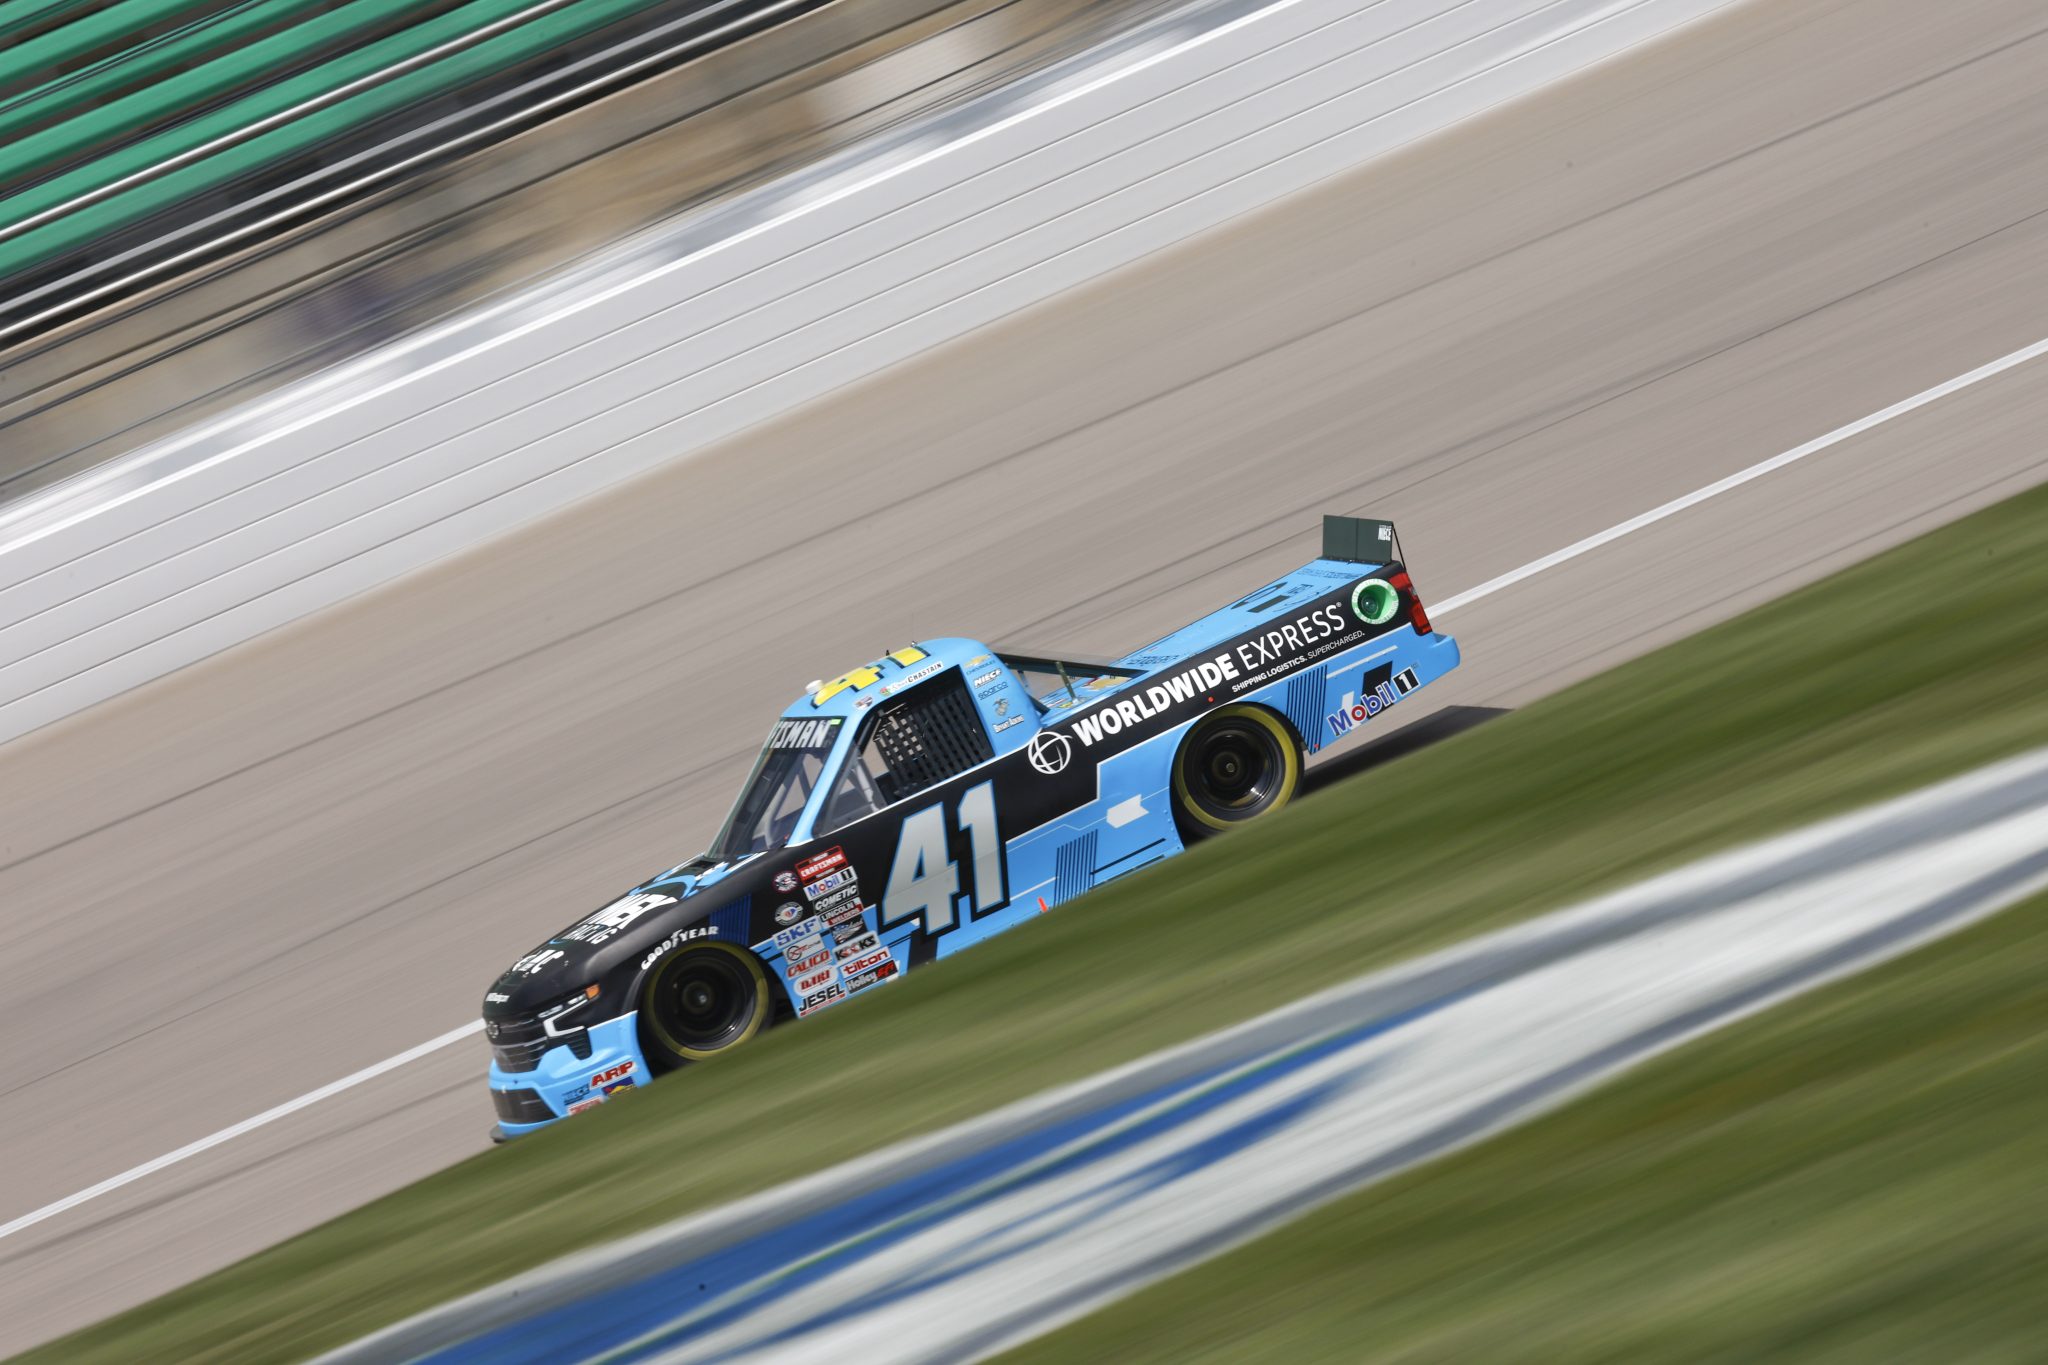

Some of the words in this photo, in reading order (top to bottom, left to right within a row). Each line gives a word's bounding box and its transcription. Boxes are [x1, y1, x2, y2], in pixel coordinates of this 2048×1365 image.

[907, 663, 943, 683] CHASTAIN
[1231, 672, 1270, 692] SHIPPING
[1266, 655, 1308, 678] LOGISTICS.
[1307, 630, 1366, 660] SUPERCHARGED.
[1071, 653, 1240, 746] WORLDWIDE
[1326, 680, 1397, 736] Mobil
[800, 853, 844, 878] CRAFTSMAN
[882, 778, 1005, 936] 41
[807, 874, 840, 897] Mobil
[815, 885, 857, 911] COMETIC
[821, 902, 855, 921] LINCOLN
[776, 917, 817, 946] SKF
[641, 925, 719, 970] GOODYEAR
[787, 949, 830, 978] CALICO
[843, 950, 888, 975] tilton
[846, 971, 877, 990] Holley
[799, 983, 845, 1012] JESEL
[592, 1061, 634, 1087] ARP
